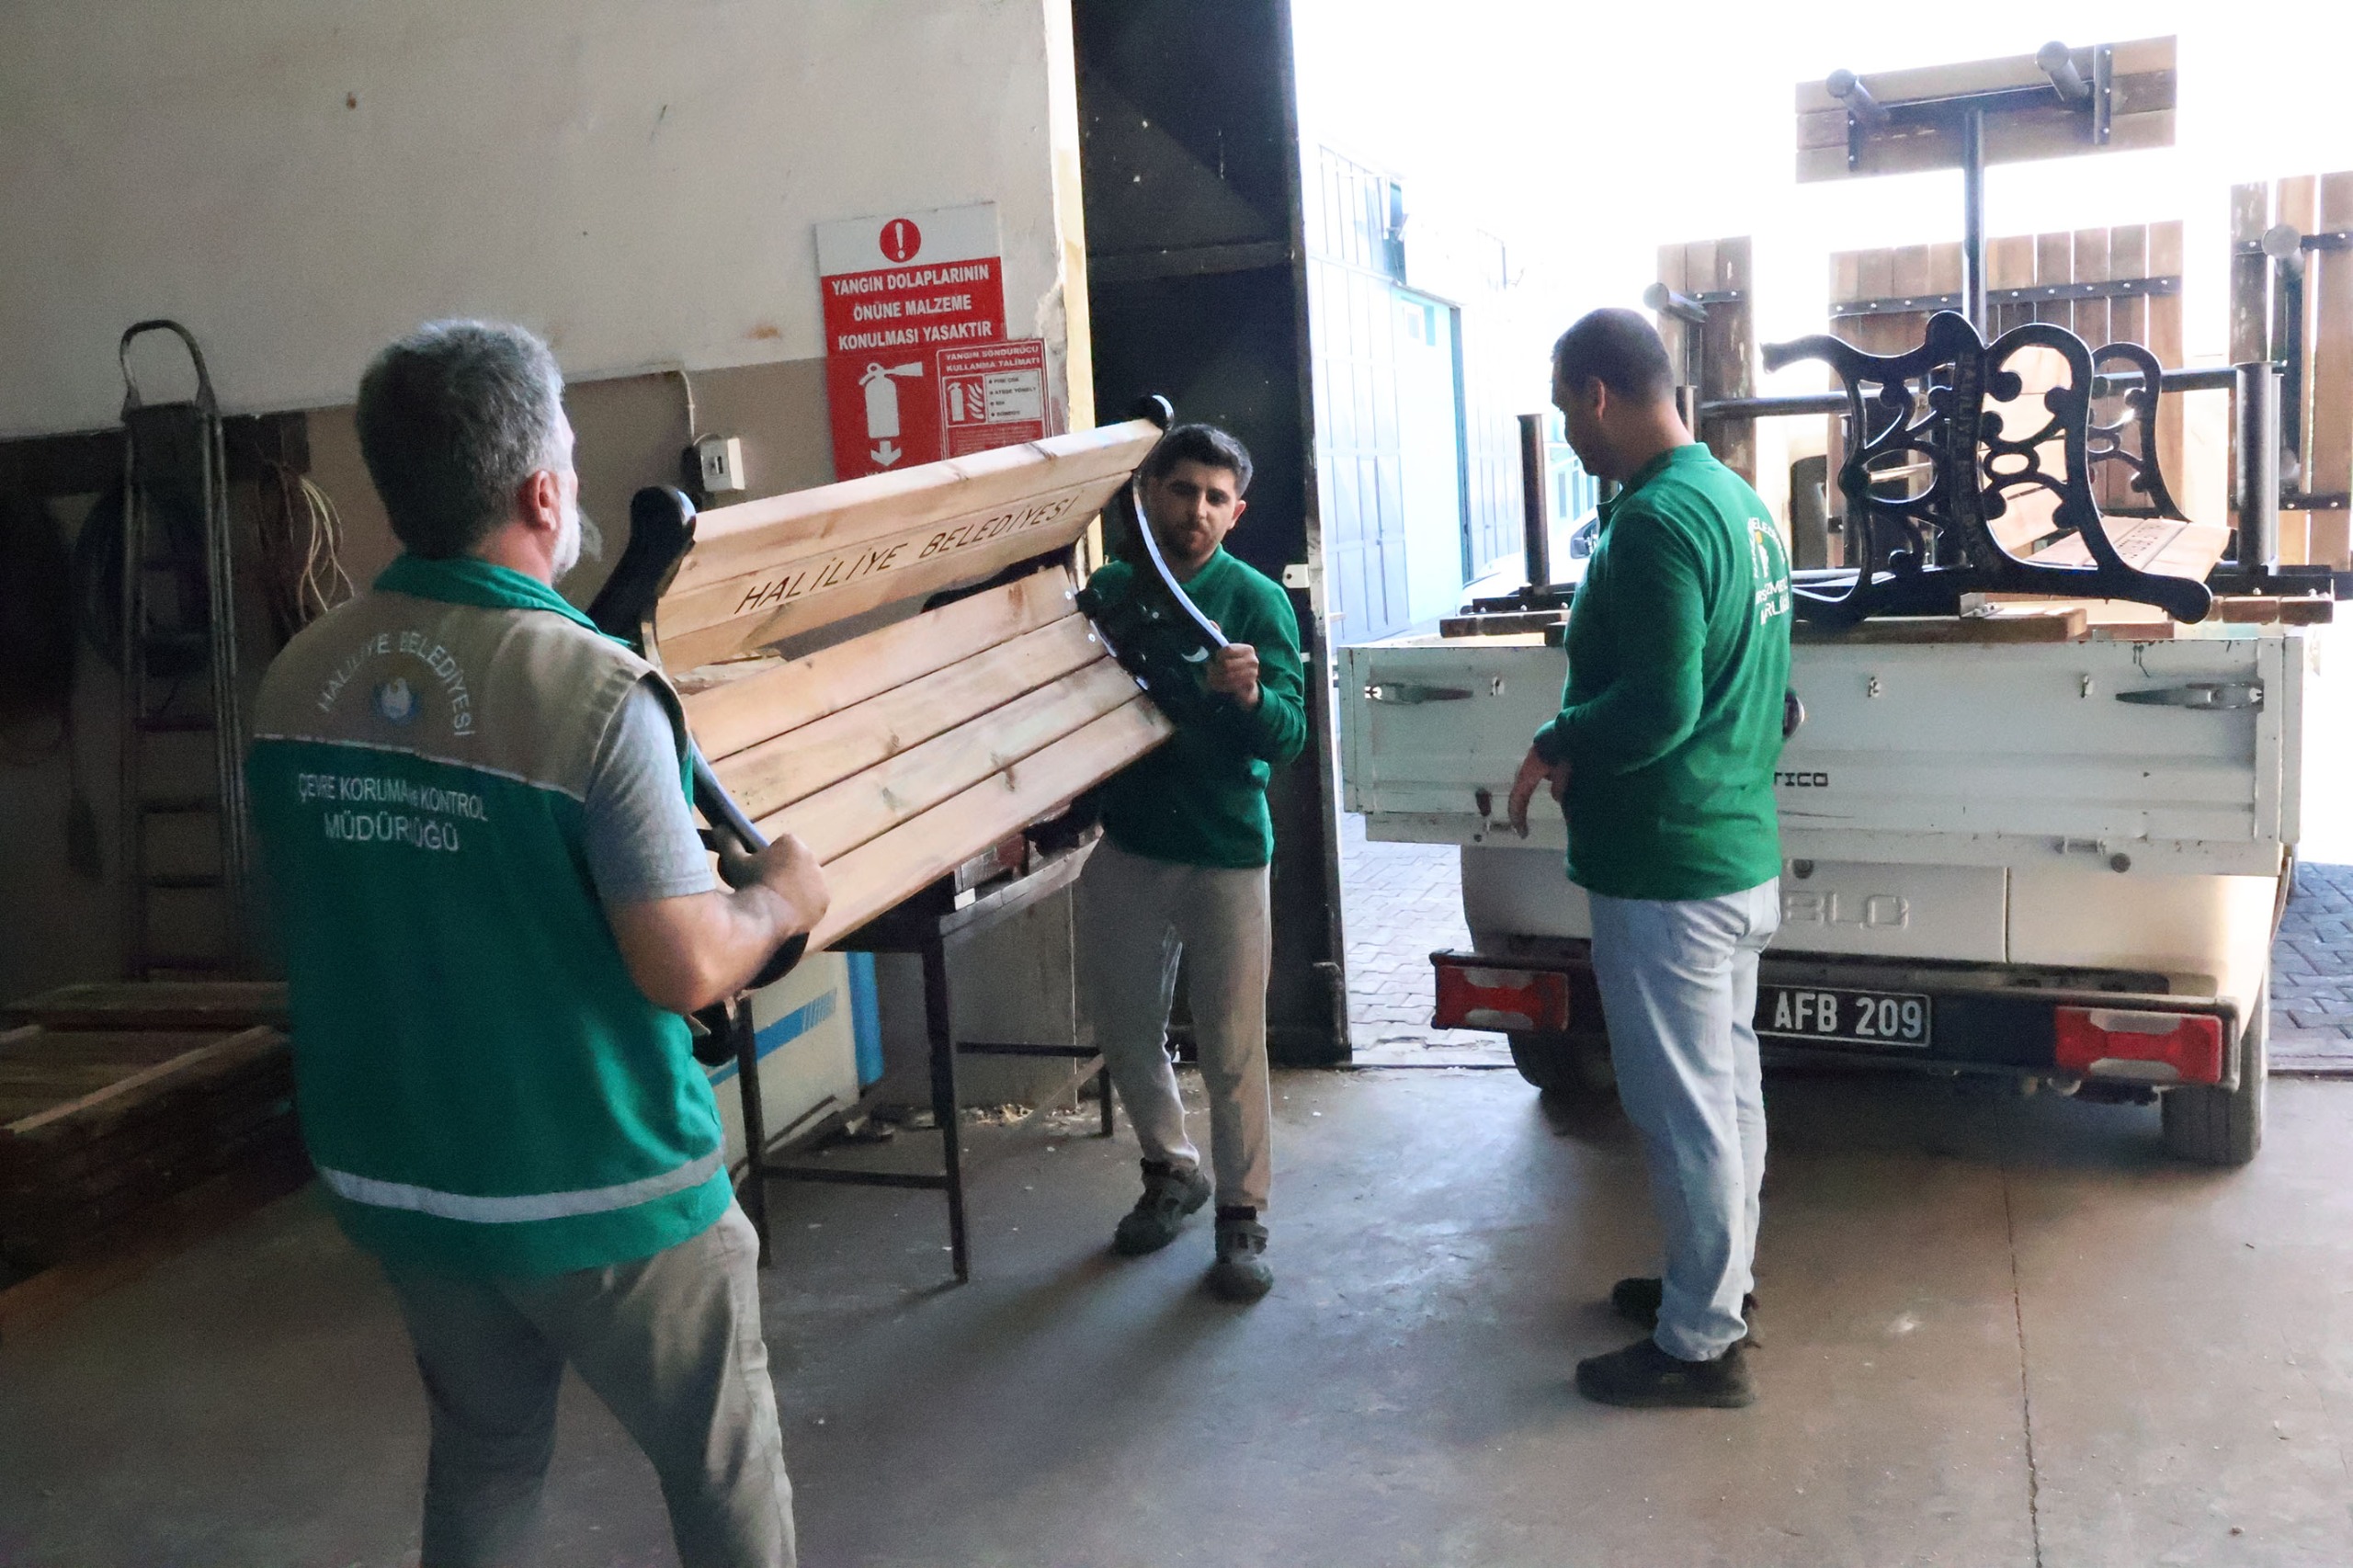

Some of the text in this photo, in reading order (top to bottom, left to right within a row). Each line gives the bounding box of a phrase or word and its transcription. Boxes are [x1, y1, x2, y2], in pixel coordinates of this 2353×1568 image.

[832, 265, 989, 295] YANGIN DOLAPLARININ
[854, 295, 972, 322] ÖNÜNE MALZEME
[838, 321, 993, 350] KONULMASI YASAKTIR
[946, 351, 979, 360] YANGIN
[946, 361, 995, 372] KULLANMA
[734, 491, 1085, 615] HALİLİYE BELEDİYESİ
[1774, 771, 1828, 787] TICO
[340, 777, 408, 801] KORUMA
[421, 785, 488, 822] KONTROL
[324, 810, 459, 851] MÜDÜRÜĞÜ
[1783, 890, 1909, 930] BLO
[1774, 991, 1923, 1039] AFB 209
